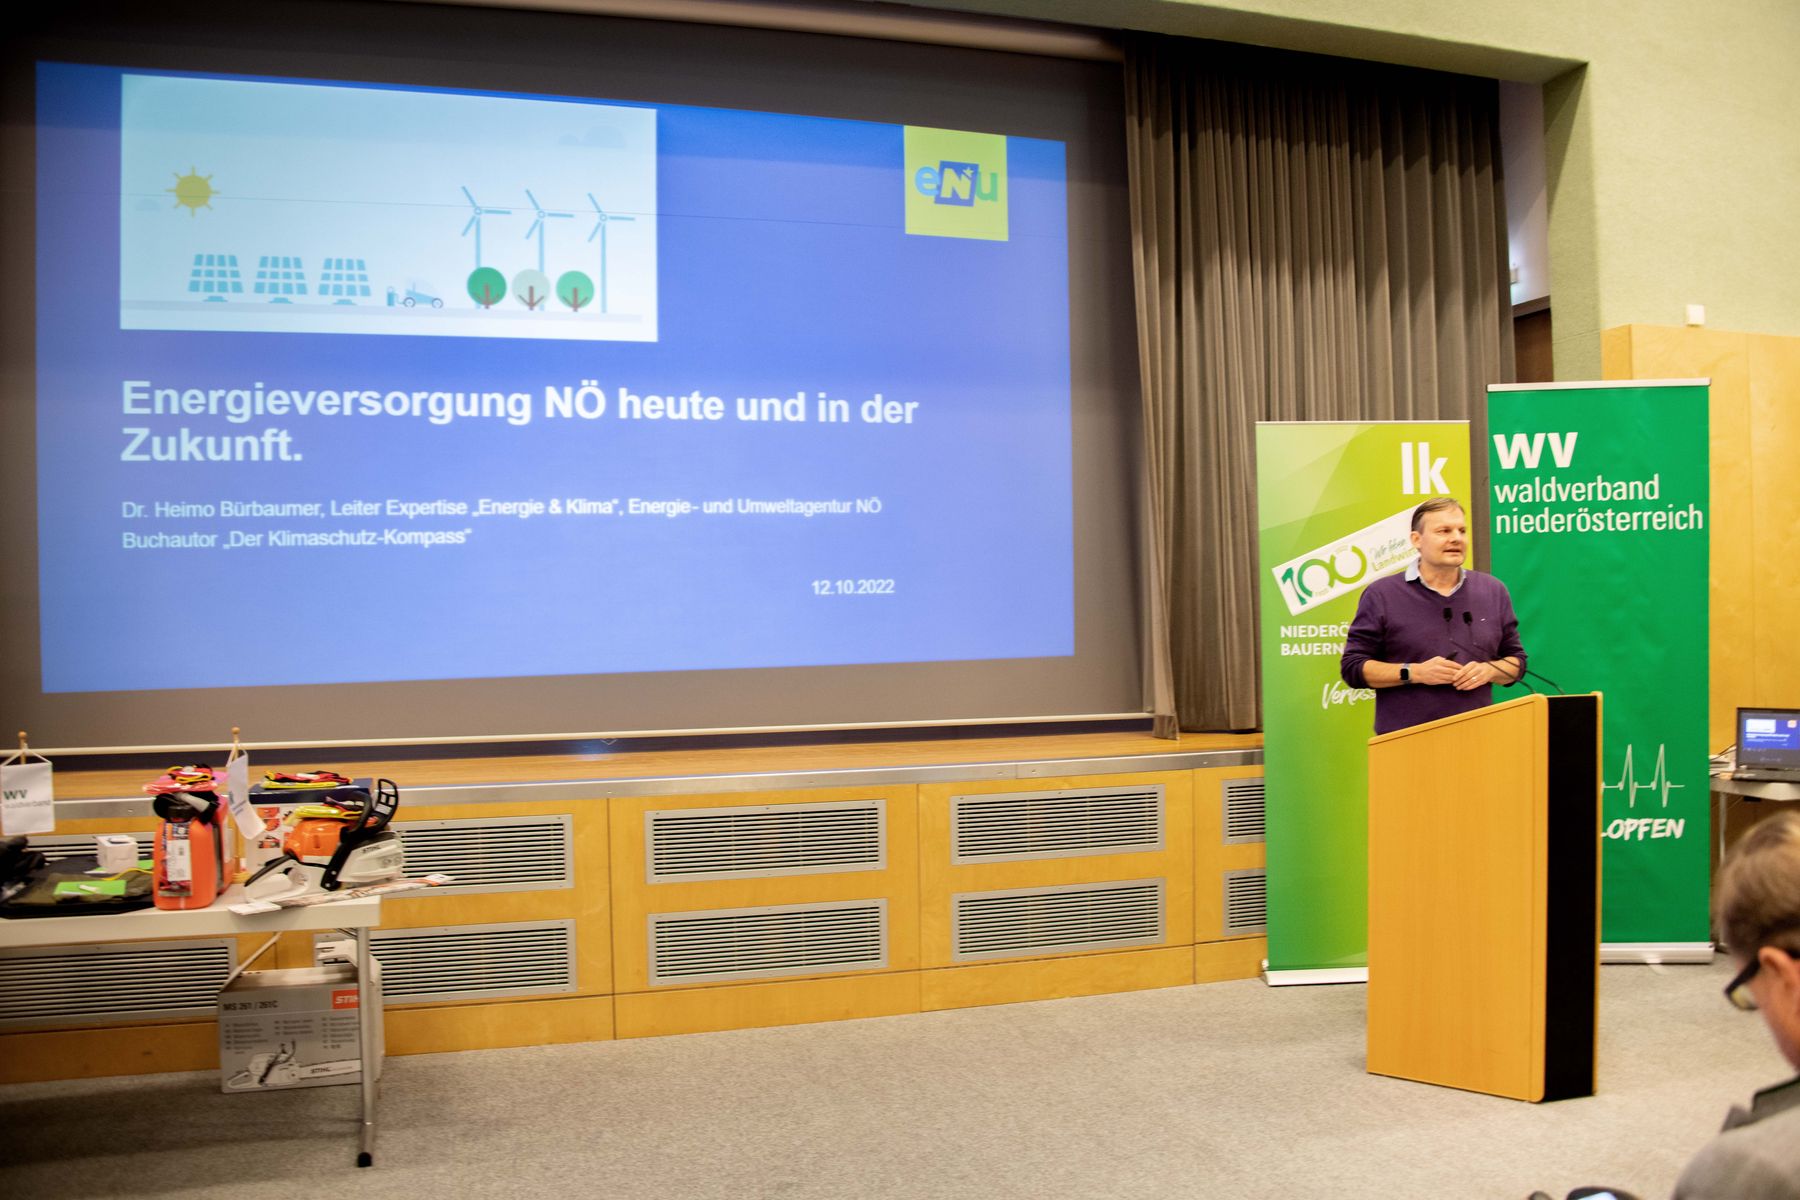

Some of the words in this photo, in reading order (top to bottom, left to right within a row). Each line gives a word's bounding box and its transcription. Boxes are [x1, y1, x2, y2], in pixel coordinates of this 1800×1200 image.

[122, 380, 531, 425] Energieversorgung
[545, 379, 606, 419] NÖ
[618, 387, 725, 420] heute
[736, 391, 806, 422] und
[818, 392, 850, 422] in
[861, 394, 919, 424] der
[121, 427, 303, 462] Zukunft.
[1494, 473, 1660, 504] waldverband
[122, 501, 149, 519] Dr.
[155, 501, 216, 518] Heimo
[220, 499, 326, 519] Bürbaumer,
[331, 499, 382, 516] Leiter
[386, 498, 468, 519] Expertise
[548, 498, 563, 515] &
[628, 498, 700, 518] Energie-
[703, 499, 734, 514] und
[738, 498, 852, 518] Umweltagentur
[856, 496, 883, 514] NÖ
[1496, 503, 1704, 534] niederösterreich
[122, 531, 218, 549] Buchautor
[811, 579, 896, 596] 12.10.2022
[1280, 621, 1351, 638] NIEDERÖ
[1280, 642, 1346, 657] BAUERN
